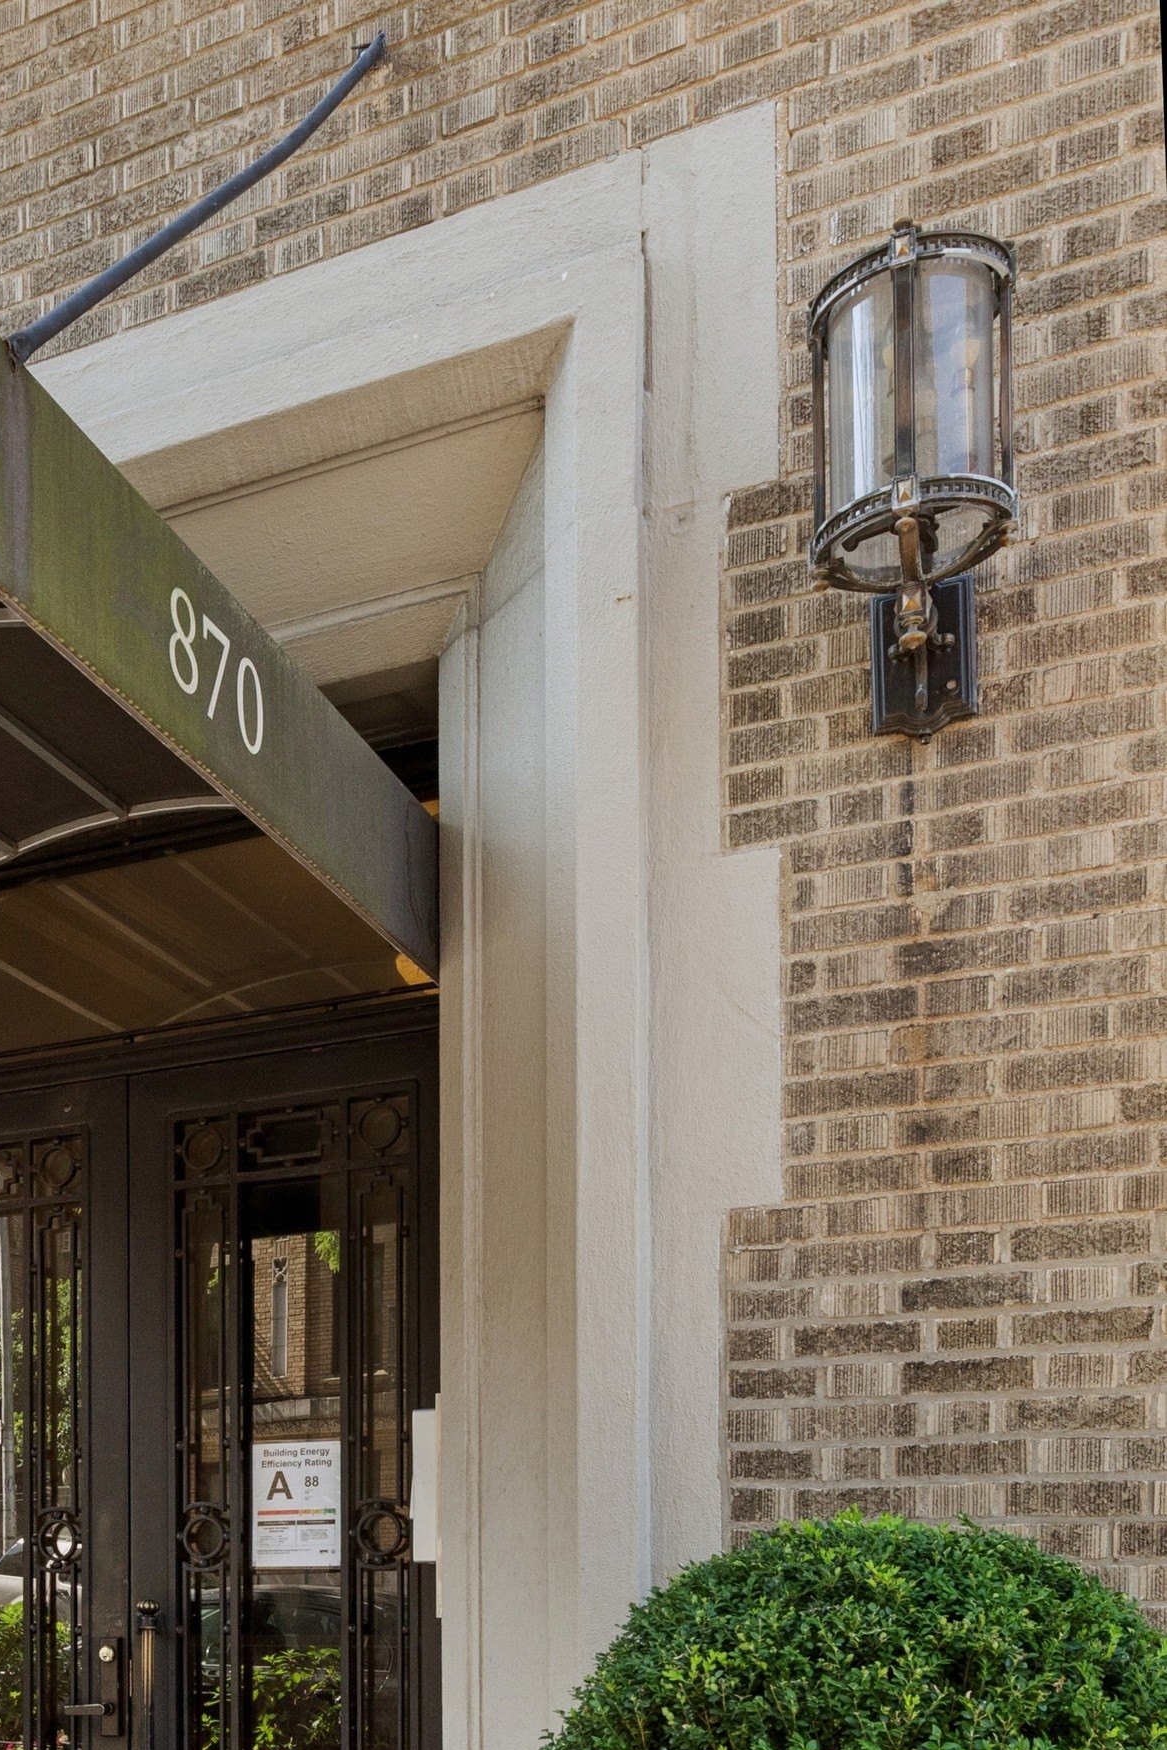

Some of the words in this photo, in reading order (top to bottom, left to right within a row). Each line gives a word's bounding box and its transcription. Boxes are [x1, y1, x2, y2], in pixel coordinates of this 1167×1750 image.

[169, 587, 263, 755] 870
[263, 1449, 298, 1458] Building
[300, 1447, 330, 1457] Energy
[261, 1459, 302, 1468] Efficiency
[304, 1458, 332, 1468] Rating
[266, 1471, 293, 1500] A
[304, 1475, 319, 1487] 88
